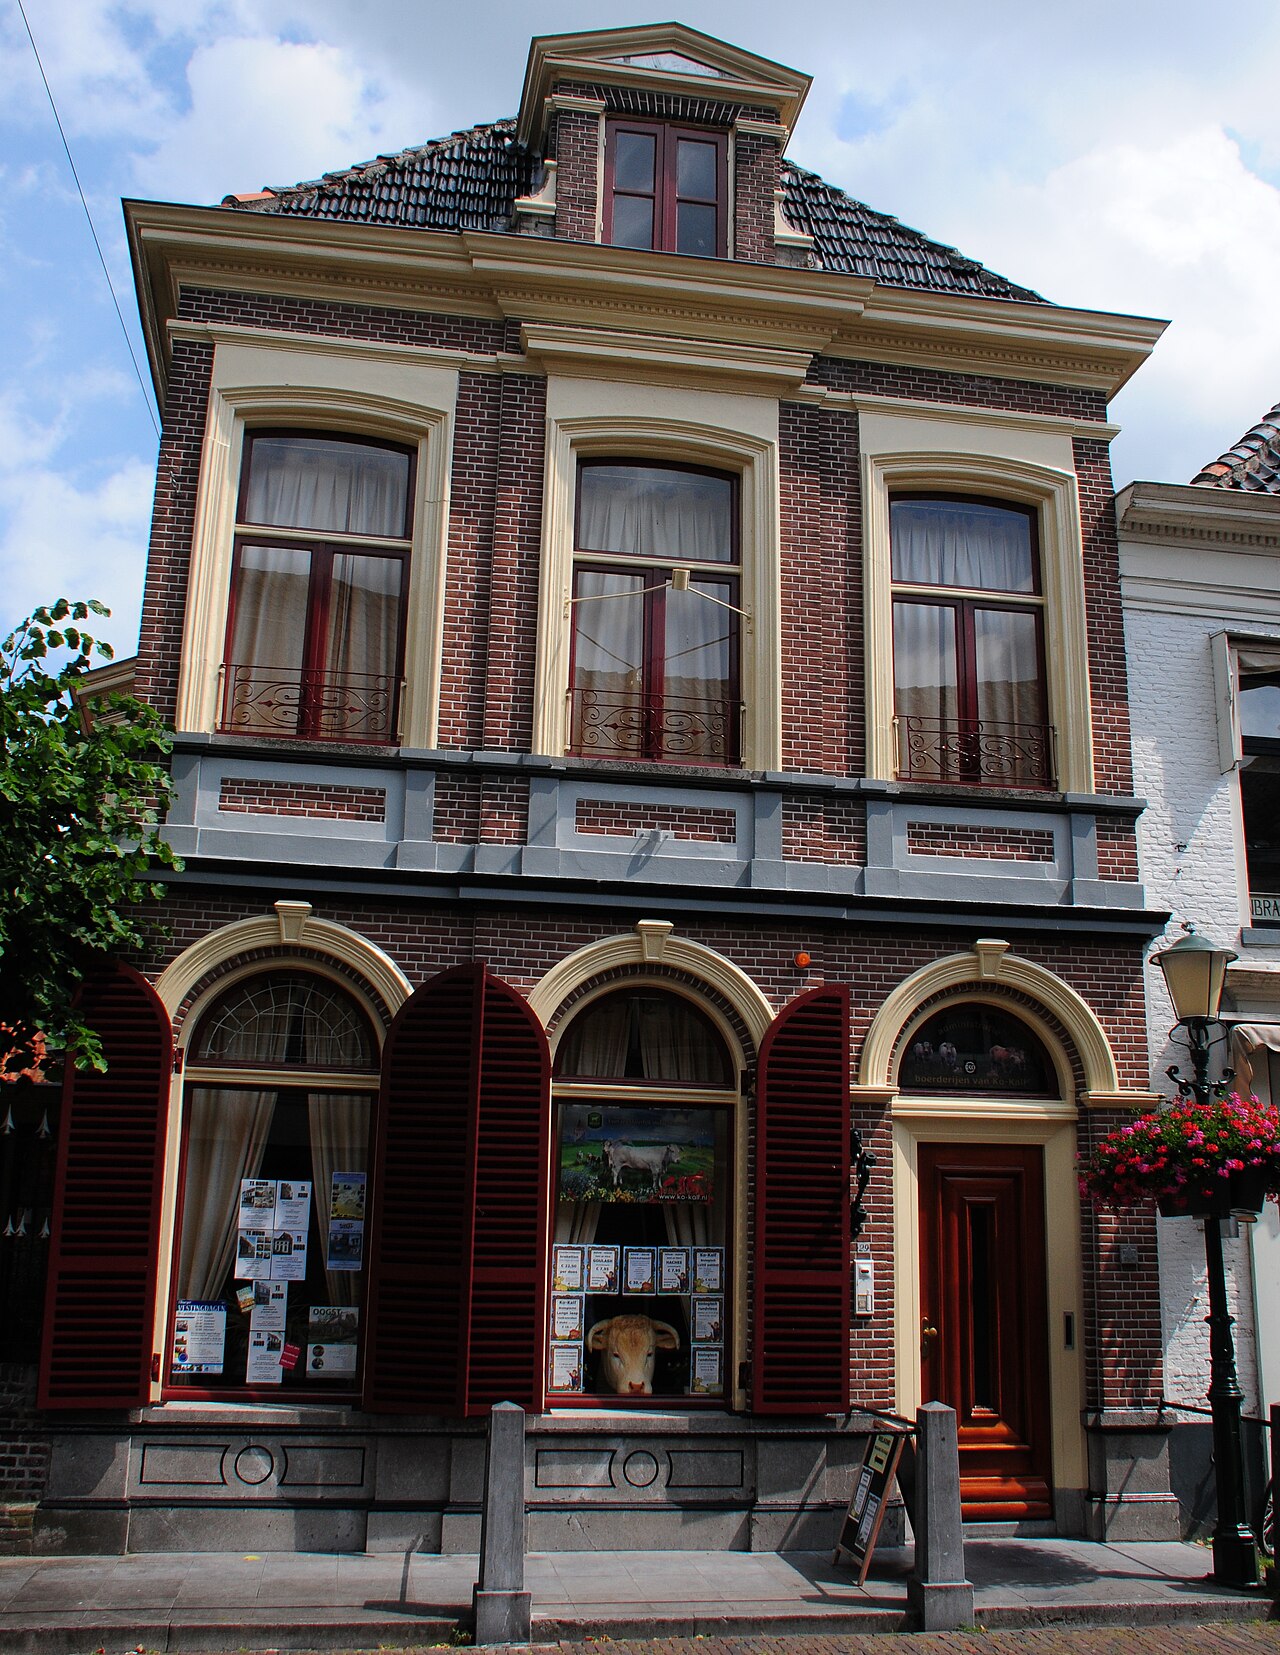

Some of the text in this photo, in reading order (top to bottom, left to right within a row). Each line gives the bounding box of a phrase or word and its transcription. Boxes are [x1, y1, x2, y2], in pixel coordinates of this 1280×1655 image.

[915, 1074, 970, 1085] boerderijen
[972, 1078, 990, 1086] van
[858, 1244, 870, 1252] 29
